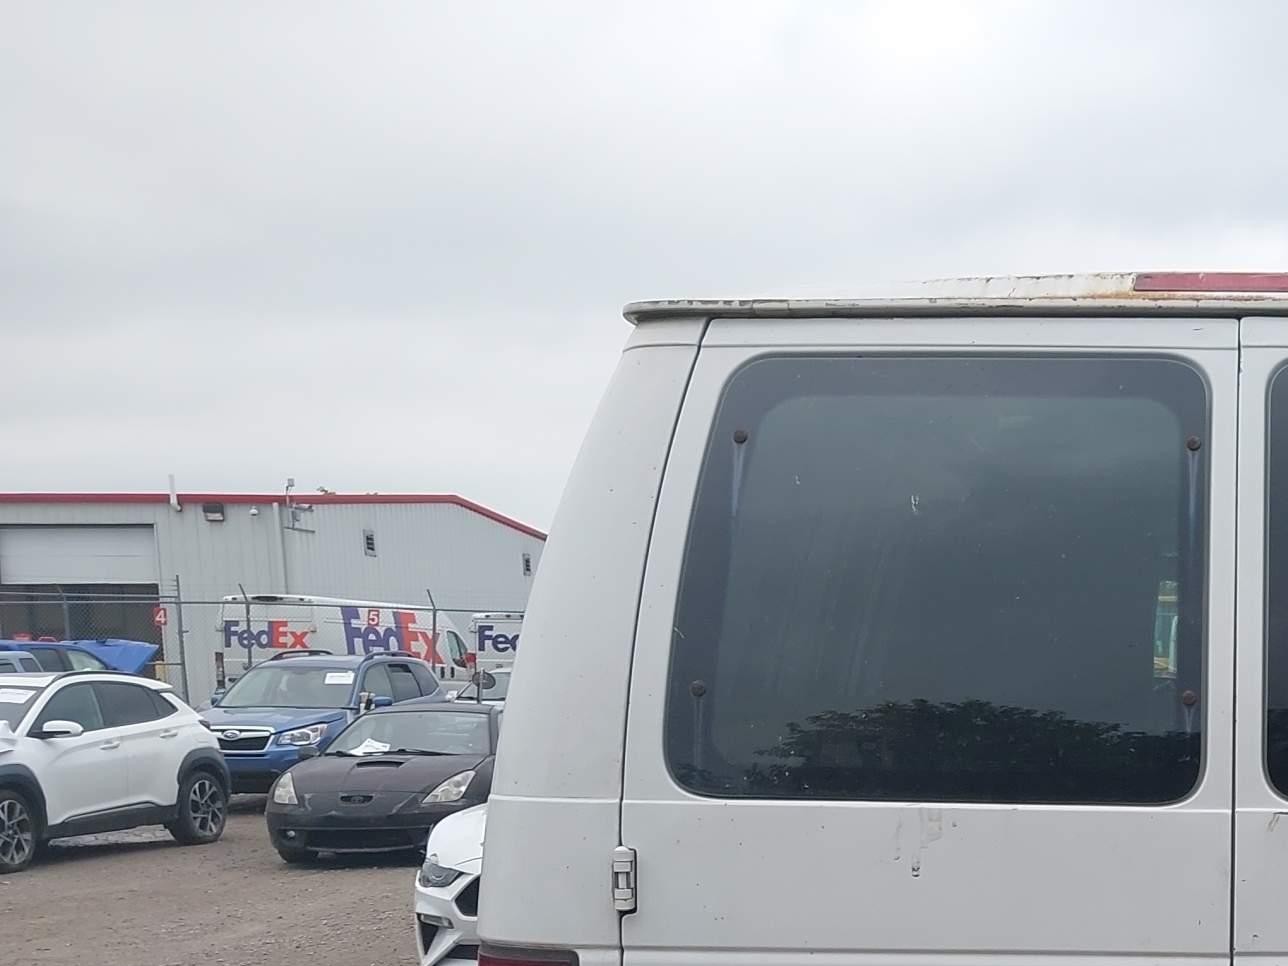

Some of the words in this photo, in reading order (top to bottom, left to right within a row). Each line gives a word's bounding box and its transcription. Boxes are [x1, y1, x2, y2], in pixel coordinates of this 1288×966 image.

[155, 609, 166, 625] 4
[369, 611, 379, 625] 5
[224, 620, 310, 649] FedEx
[341, 607, 445, 664] FedEx
